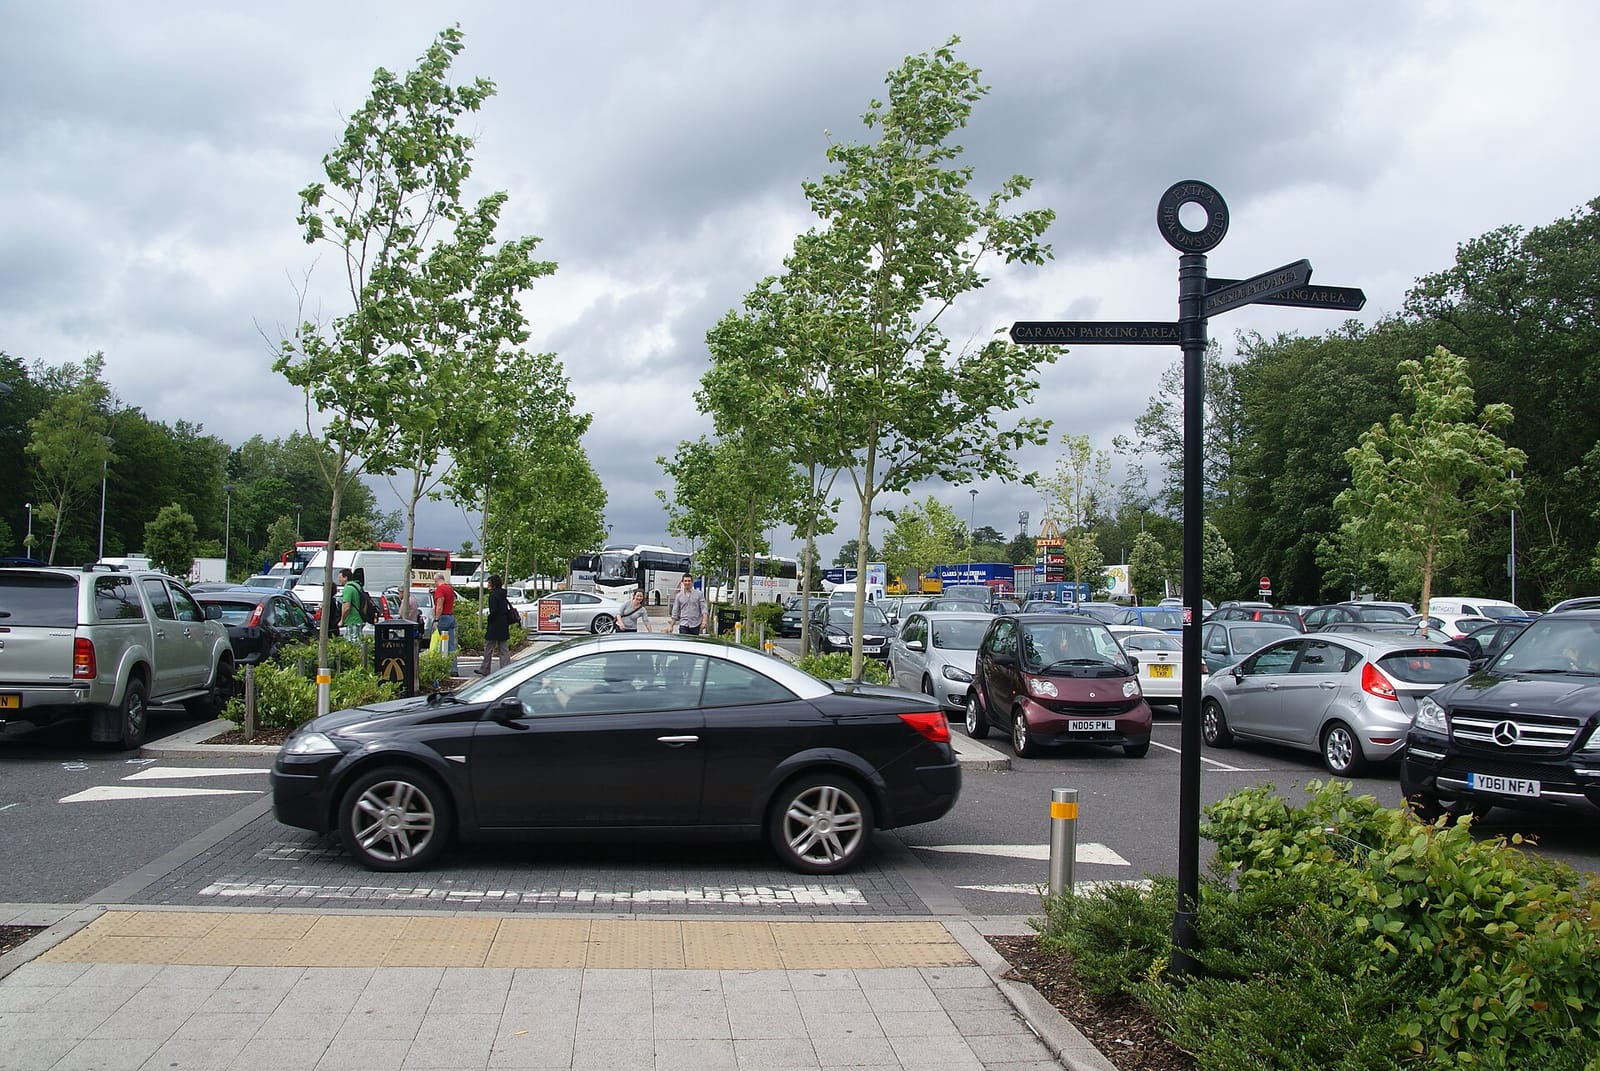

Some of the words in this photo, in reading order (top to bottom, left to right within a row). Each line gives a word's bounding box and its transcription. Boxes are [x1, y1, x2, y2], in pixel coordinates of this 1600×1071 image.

[1172, 185, 1215, 204] EXTRA
[1164, 206, 1225, 247] BEACONSFIELD
[1207, 289, 1245, 309] LAKESIDE
[1247, 278, 1270, 296] PATIO
[1270, 270, 1298, 287] AREA
[1310, 291, 1346, 303] AREA
[1016, 327, 1076, 338] CARAVAN
[1080, 327, 1137, 338] PARKING
[1140, 327, 1177, 338] AREA
[1072, 721, 1094, 730] ND05
[1096, 721, 1112, 730] PWL
[1478, 775, 1505, 790] YD61
[1508, 780, 1535, 794] NFA
